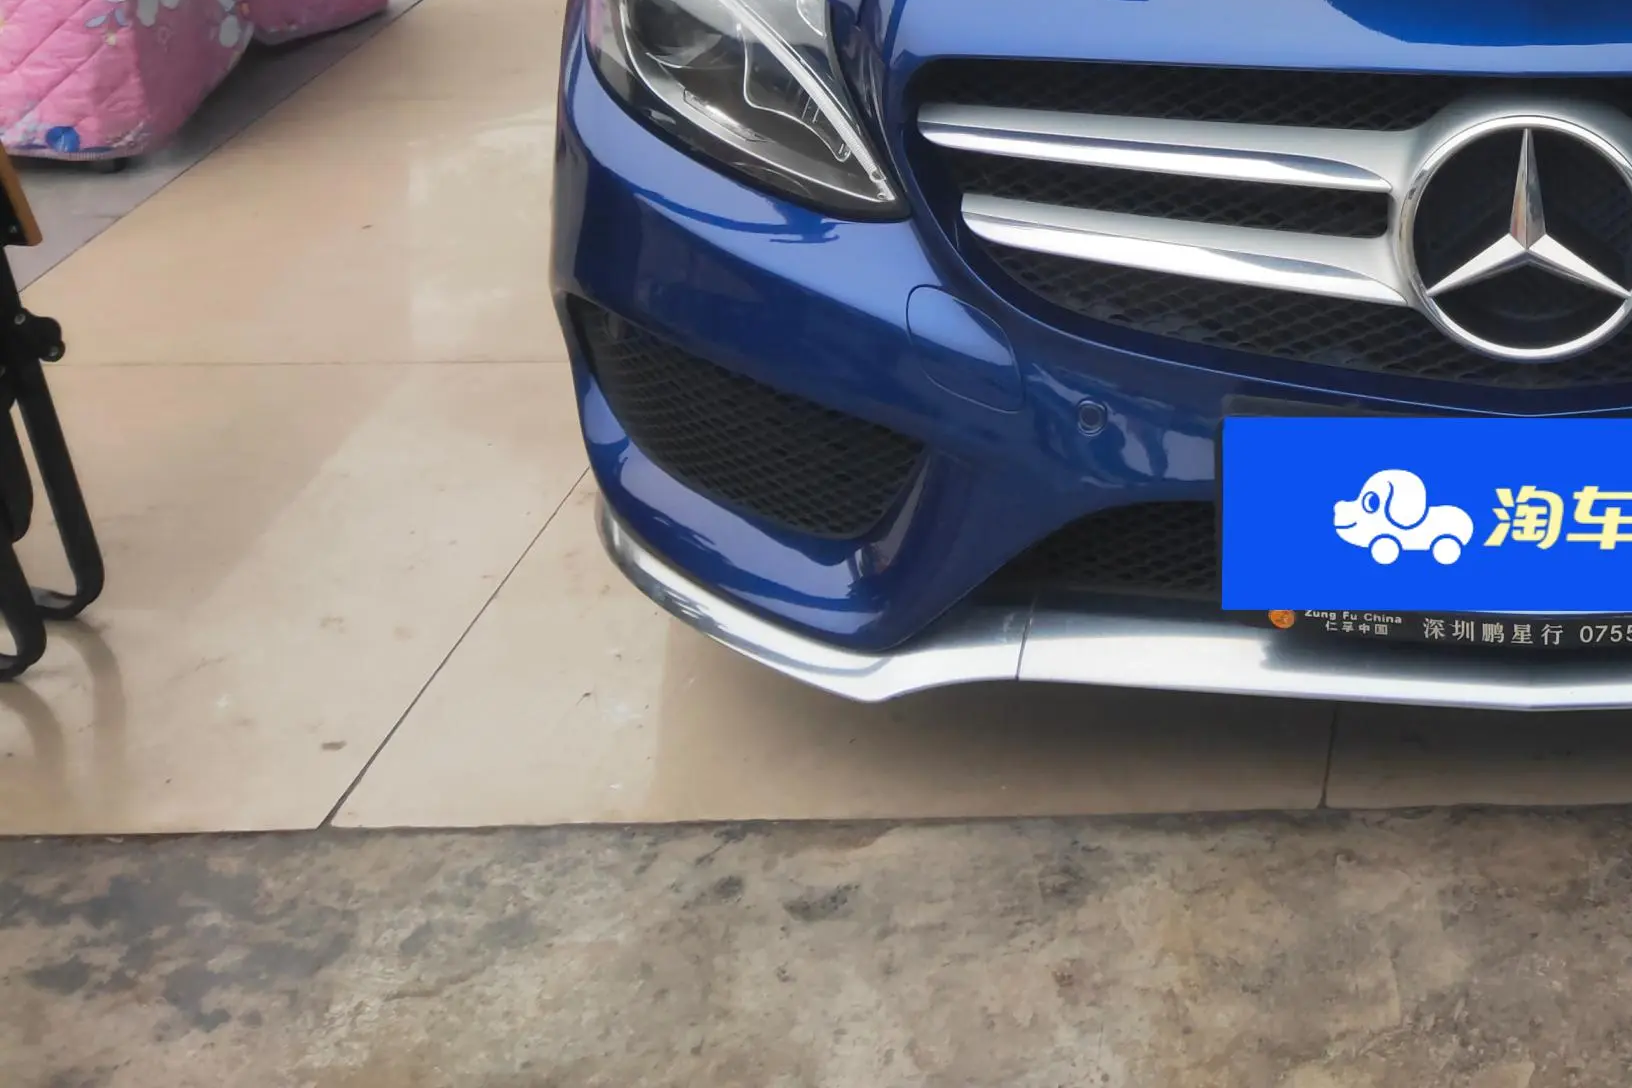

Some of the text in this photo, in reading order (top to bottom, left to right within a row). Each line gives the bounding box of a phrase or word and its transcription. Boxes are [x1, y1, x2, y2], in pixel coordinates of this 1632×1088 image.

[1304, 610, 1402, 624] Zung Fu China
[1422, 617, 1564, 645] 深圳鹏星行
